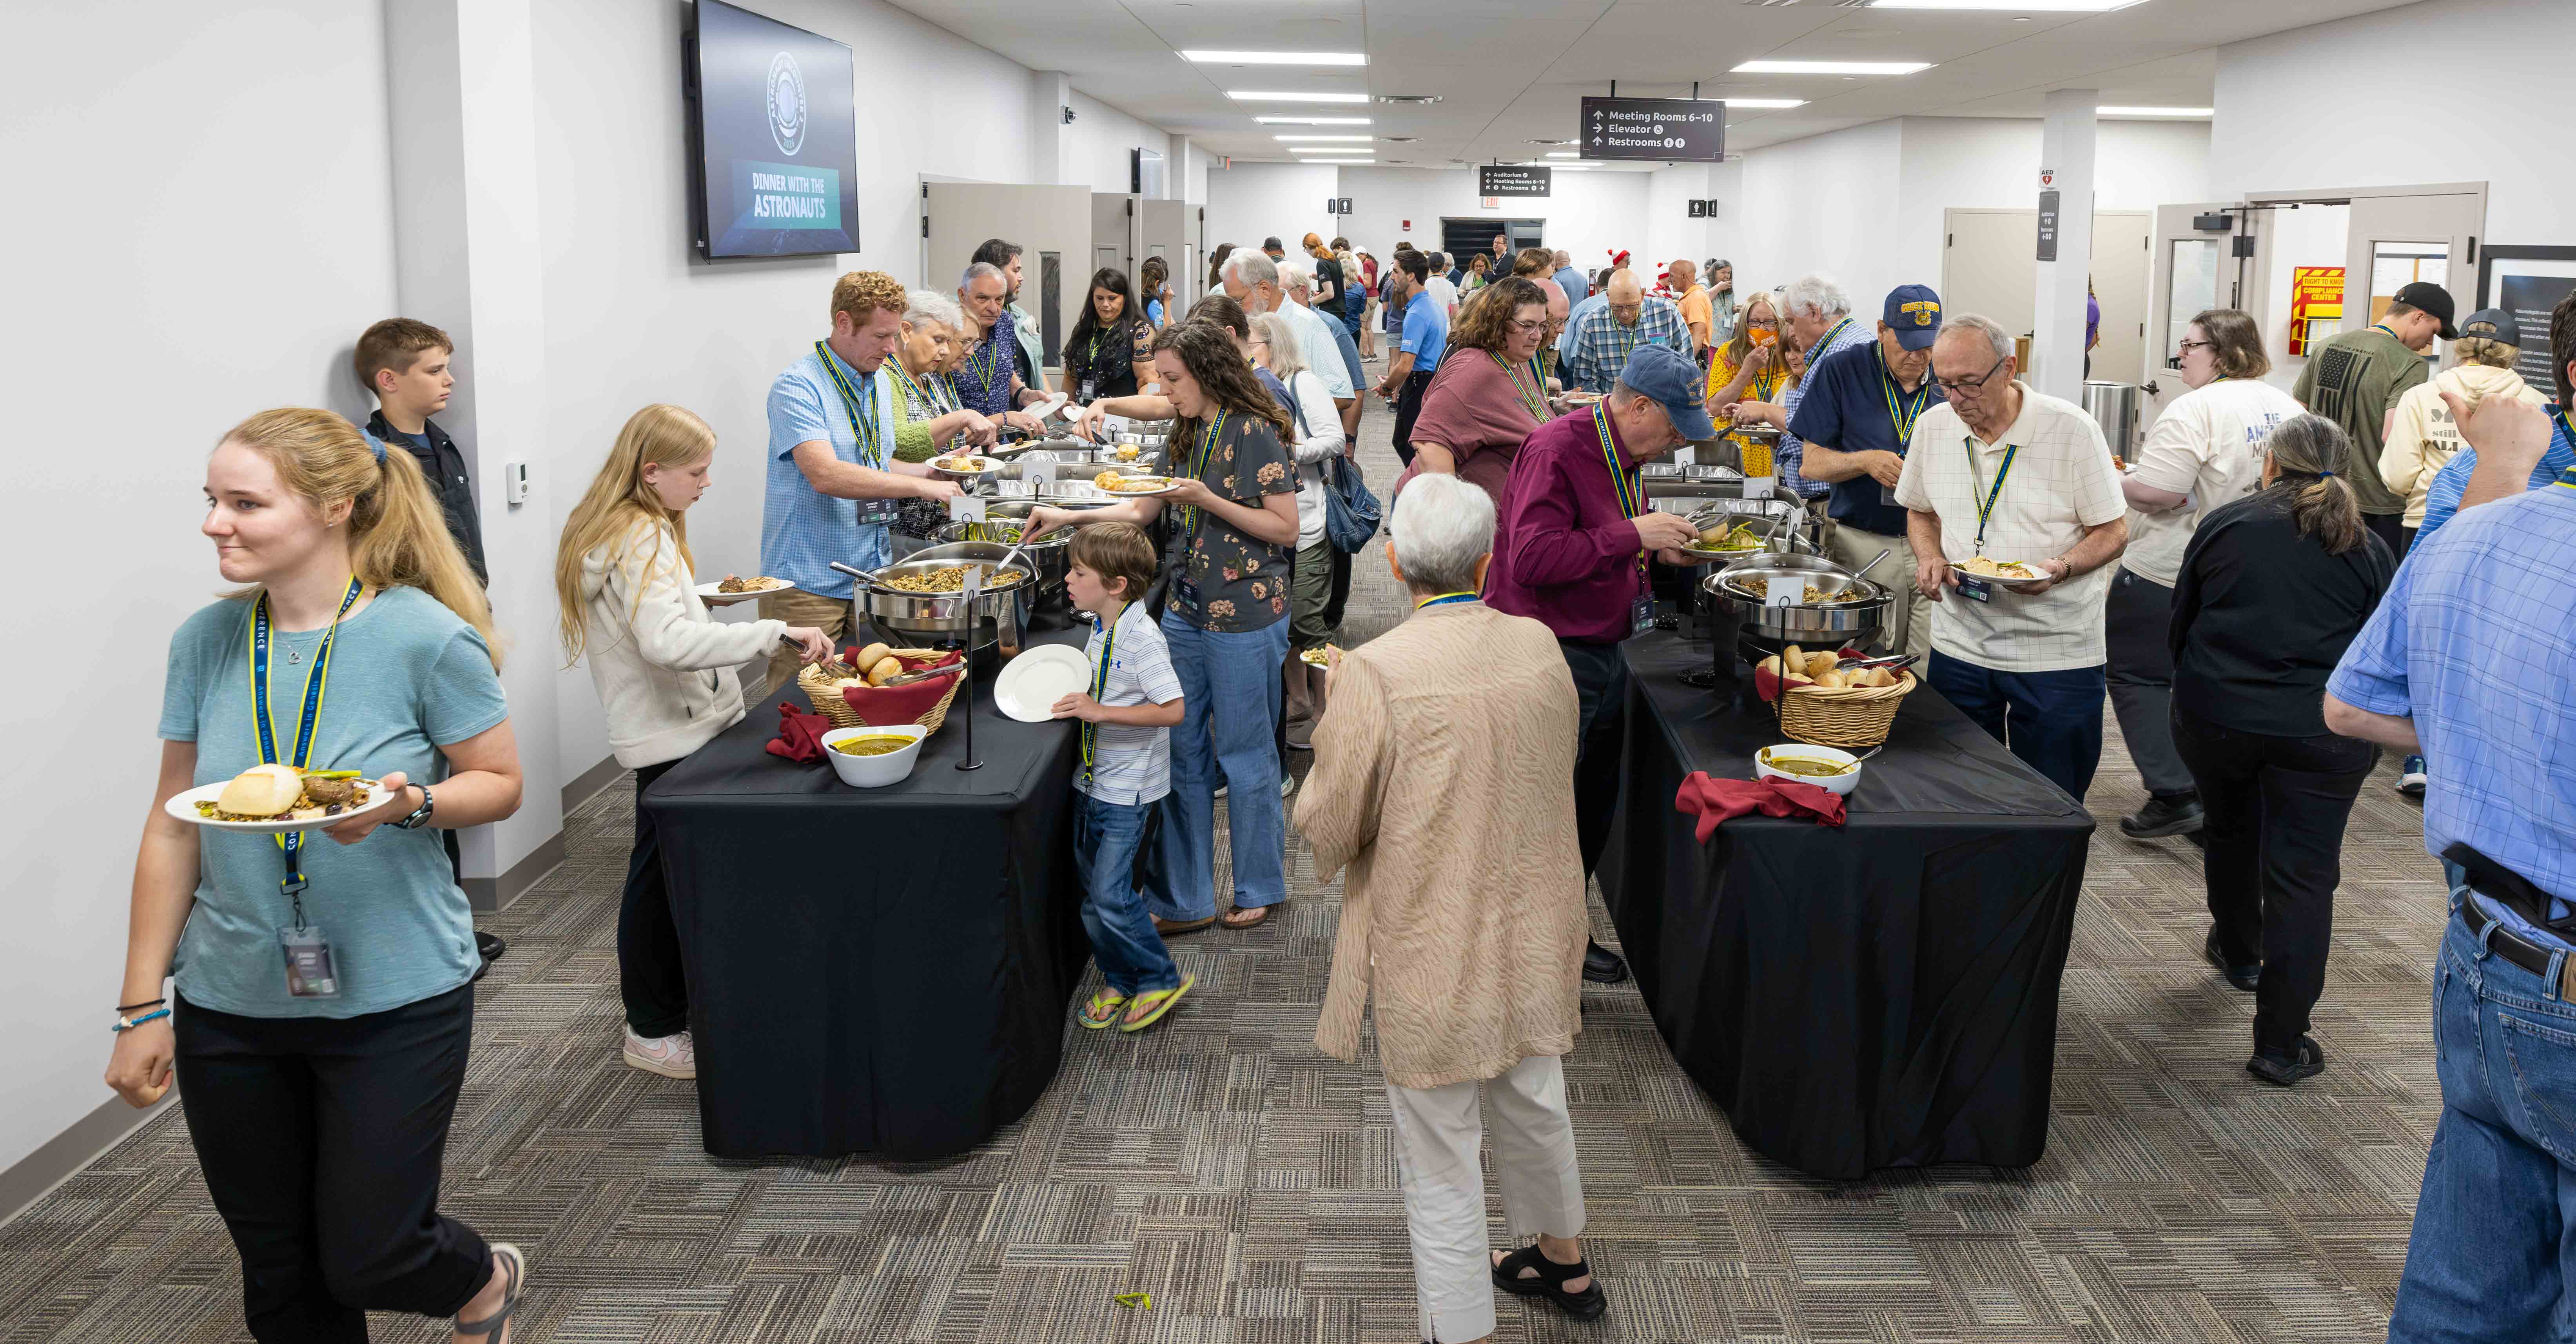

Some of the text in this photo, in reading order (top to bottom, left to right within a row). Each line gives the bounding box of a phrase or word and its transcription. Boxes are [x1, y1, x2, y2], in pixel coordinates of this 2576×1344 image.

[1609, 111, 1650, 122] Meeting
[1653, 113, 1686, 122] Rooms
[1609, 124, 1651, 134] Elevator
[1609, 137, 1662, 147] Restrooms
[753, 173, 825, 194] DINNER WITH THE
[754, 194, 825, 218] ASTRONAUTS
[1486, 197, 1498, 207] EXIT
[1901, 301, 1923, 313] COAST
[890, 358, 905, 377] CONFERENCE
[1212, 409, 1225, 439] CONFERENCE
[1598, 419, 1611, 451] CONFERENCE
[1983, 494, 1996, 523] CONFERENCE
[299, 723, 311, 757] Answers
[307, 680, 319, 711] Genesis
[262, 731, 272, 761] Genesis
